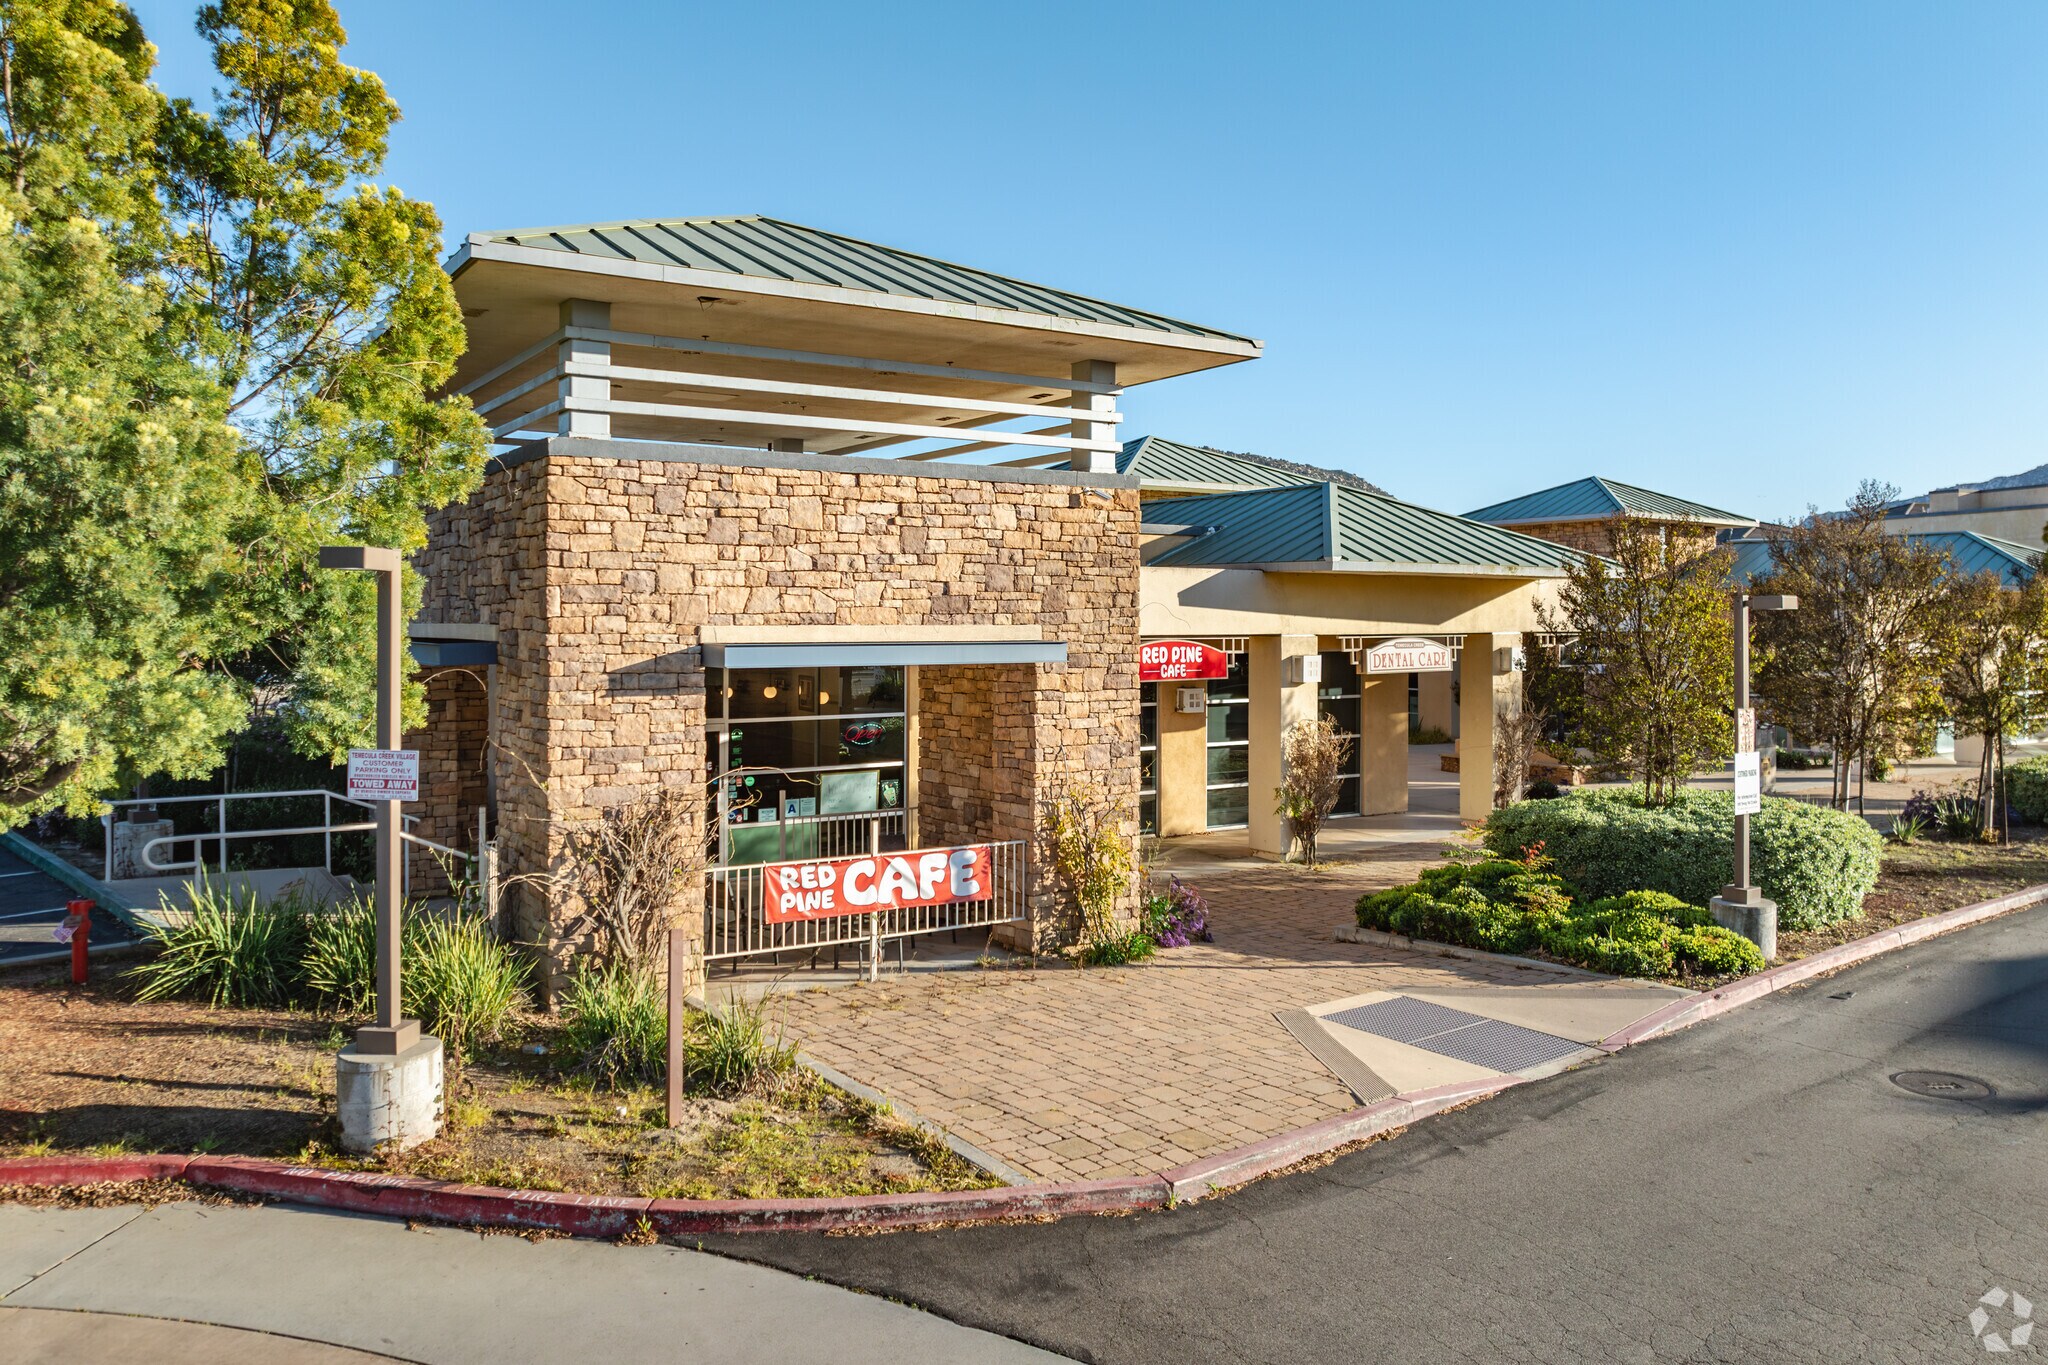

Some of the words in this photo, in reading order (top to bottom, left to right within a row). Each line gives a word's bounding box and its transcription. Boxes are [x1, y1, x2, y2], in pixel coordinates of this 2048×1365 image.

[1142, 646, 1168, 664] RED
[1172, 646, 1203, 663] PINE
[1373, 652, 1414, 668] DENTAL
[1418, 652, 1446, 666] CARE
[1160, 664, 1187, 678] CAFE
[844, 726, 883, 741] Open
[352, 779, 384, 788] TOWED
[387, 780, 414, 789] AWAY
[780, 864, 836, 892] RED
[842, 850, 981, 906] CAFE
[780, 889, 836, 914] PINE
[283, 1167, 314, 1176] NO
[322, 1171, 409, 1186] PARKING
[506, 1190, 562, 1203] FIRE
[574, 1196, 634, 1208] LANE
